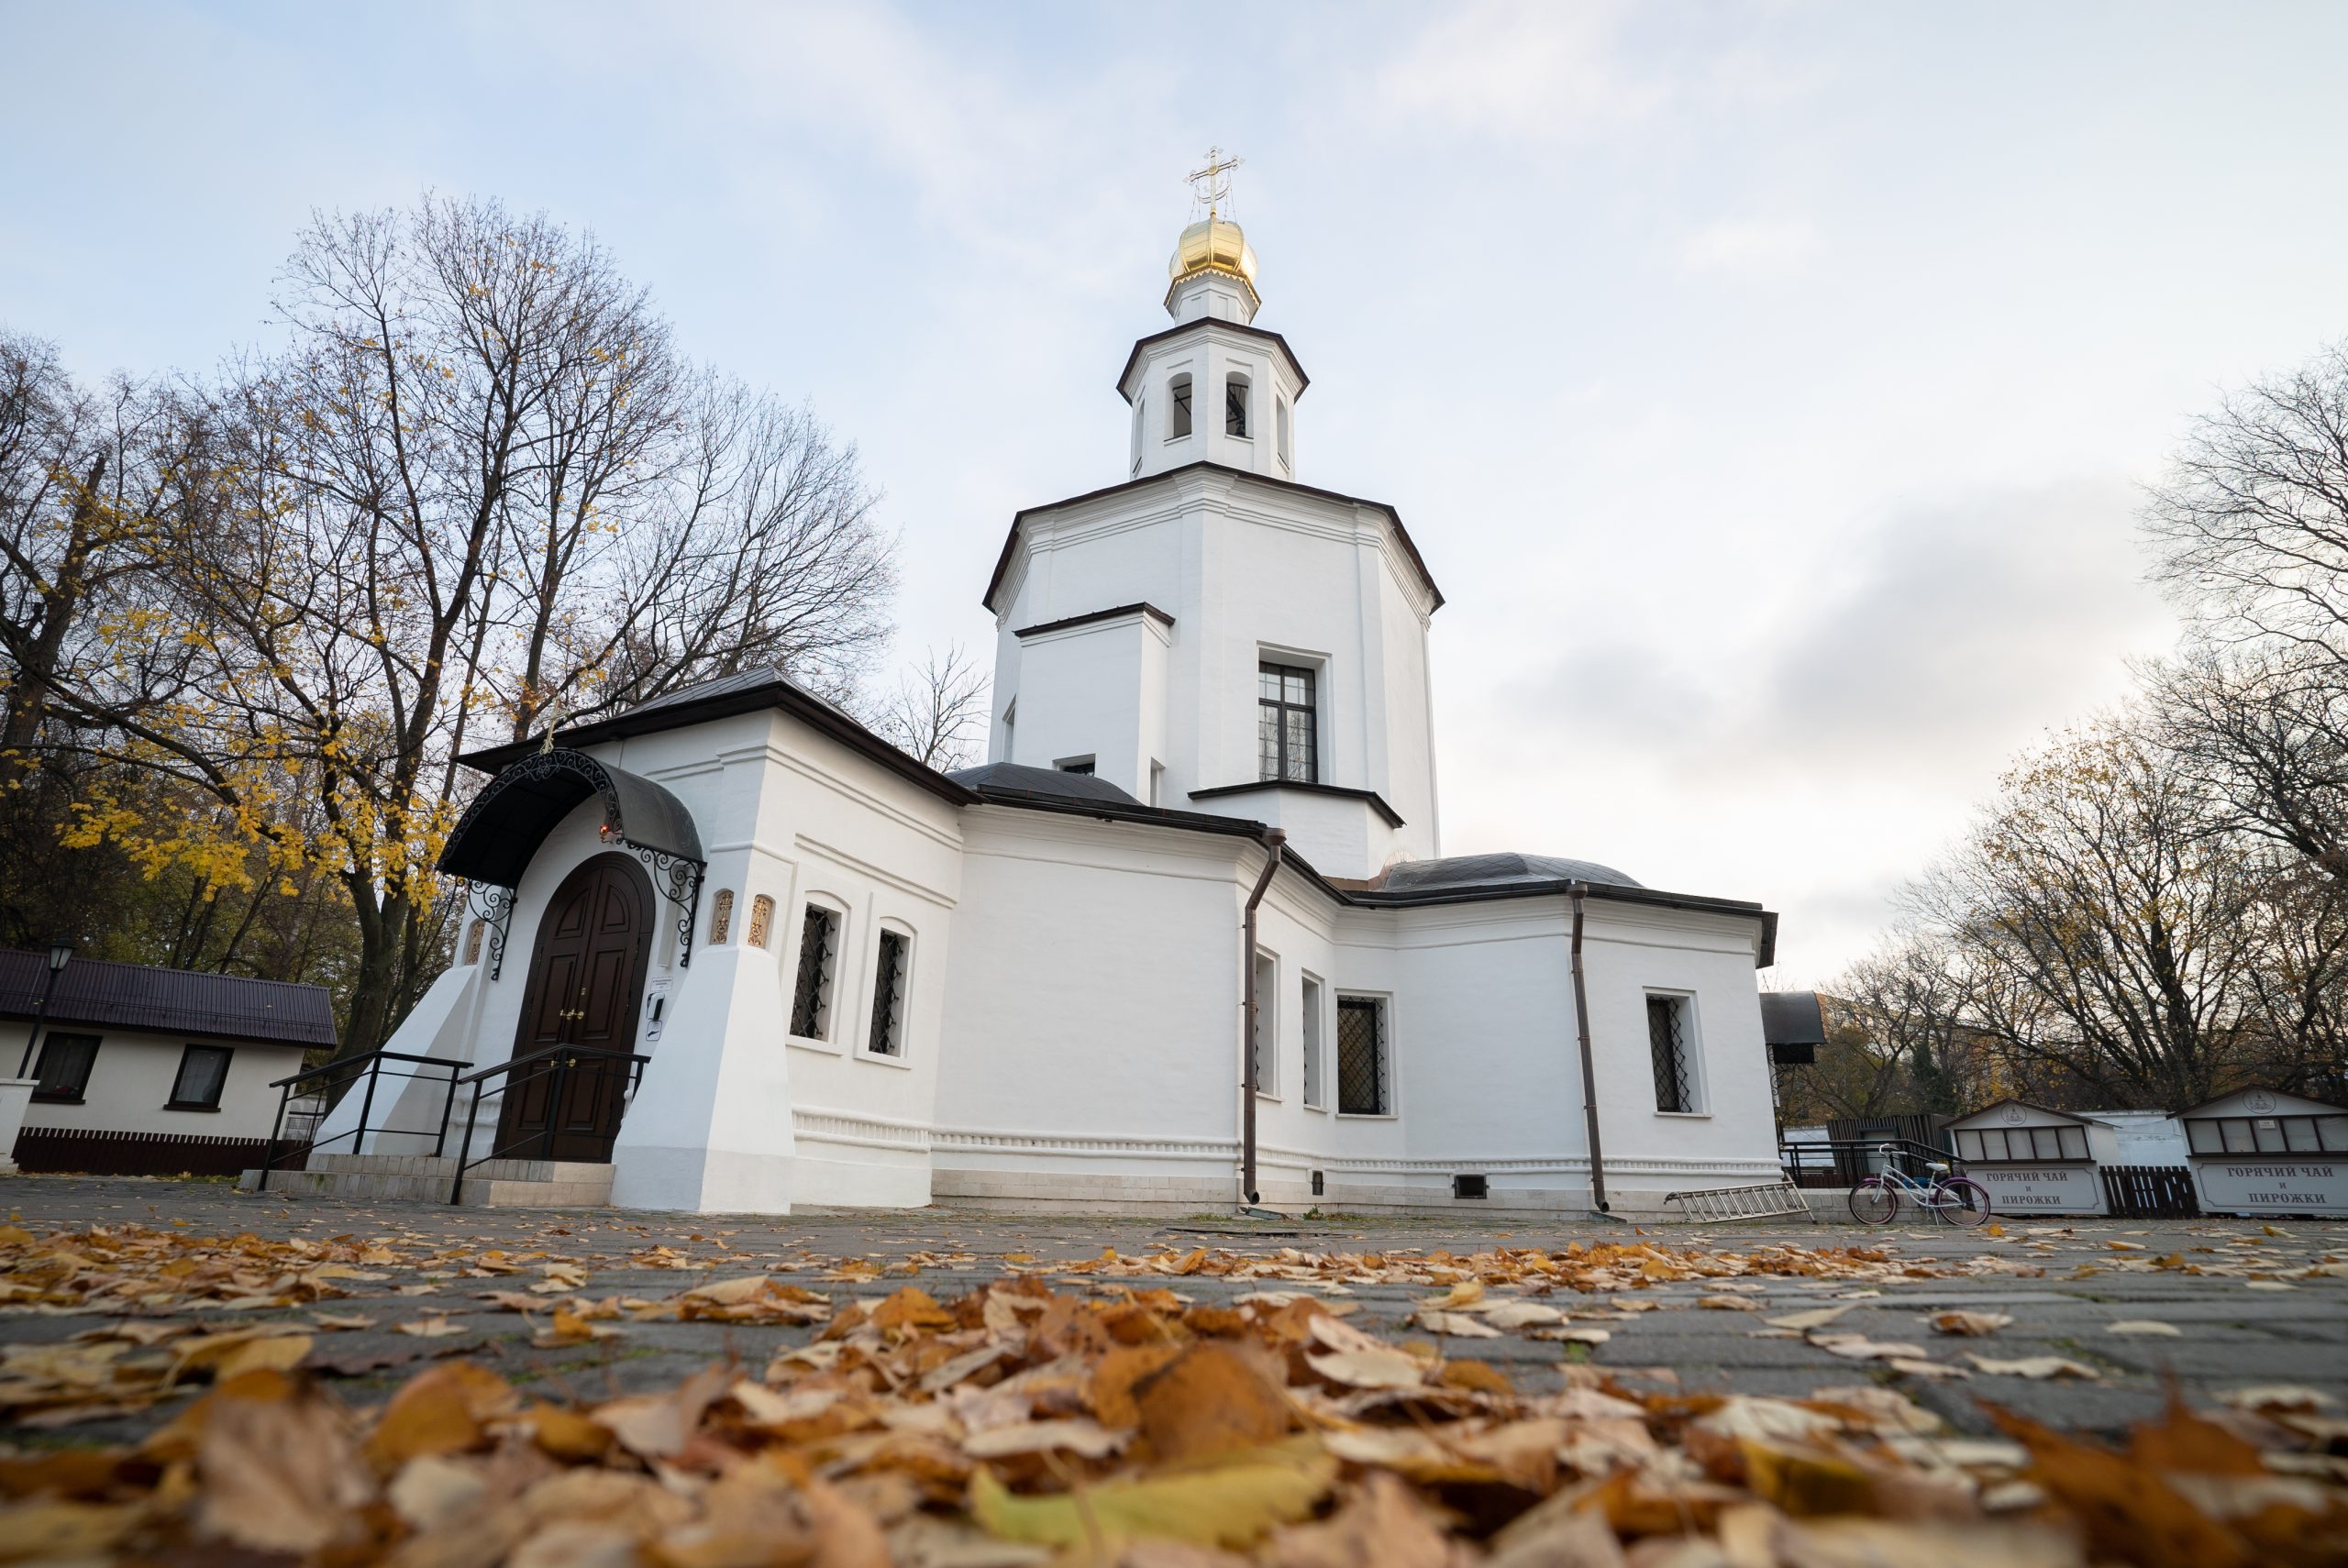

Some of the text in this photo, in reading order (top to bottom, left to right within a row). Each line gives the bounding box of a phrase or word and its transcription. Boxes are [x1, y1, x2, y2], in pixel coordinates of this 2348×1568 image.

[1986, 1171, 2068, 1182] ГОРЯЧИЙ ЧАЙ
[2226, 1165, 2334, 1177] ГОРЯЧИЙ ЧАЙ
[2001, 1195, 2062, 1205] ПИРОЖКИ
[2247, 1193, 2327, 1204] ПИРОЖКИ
